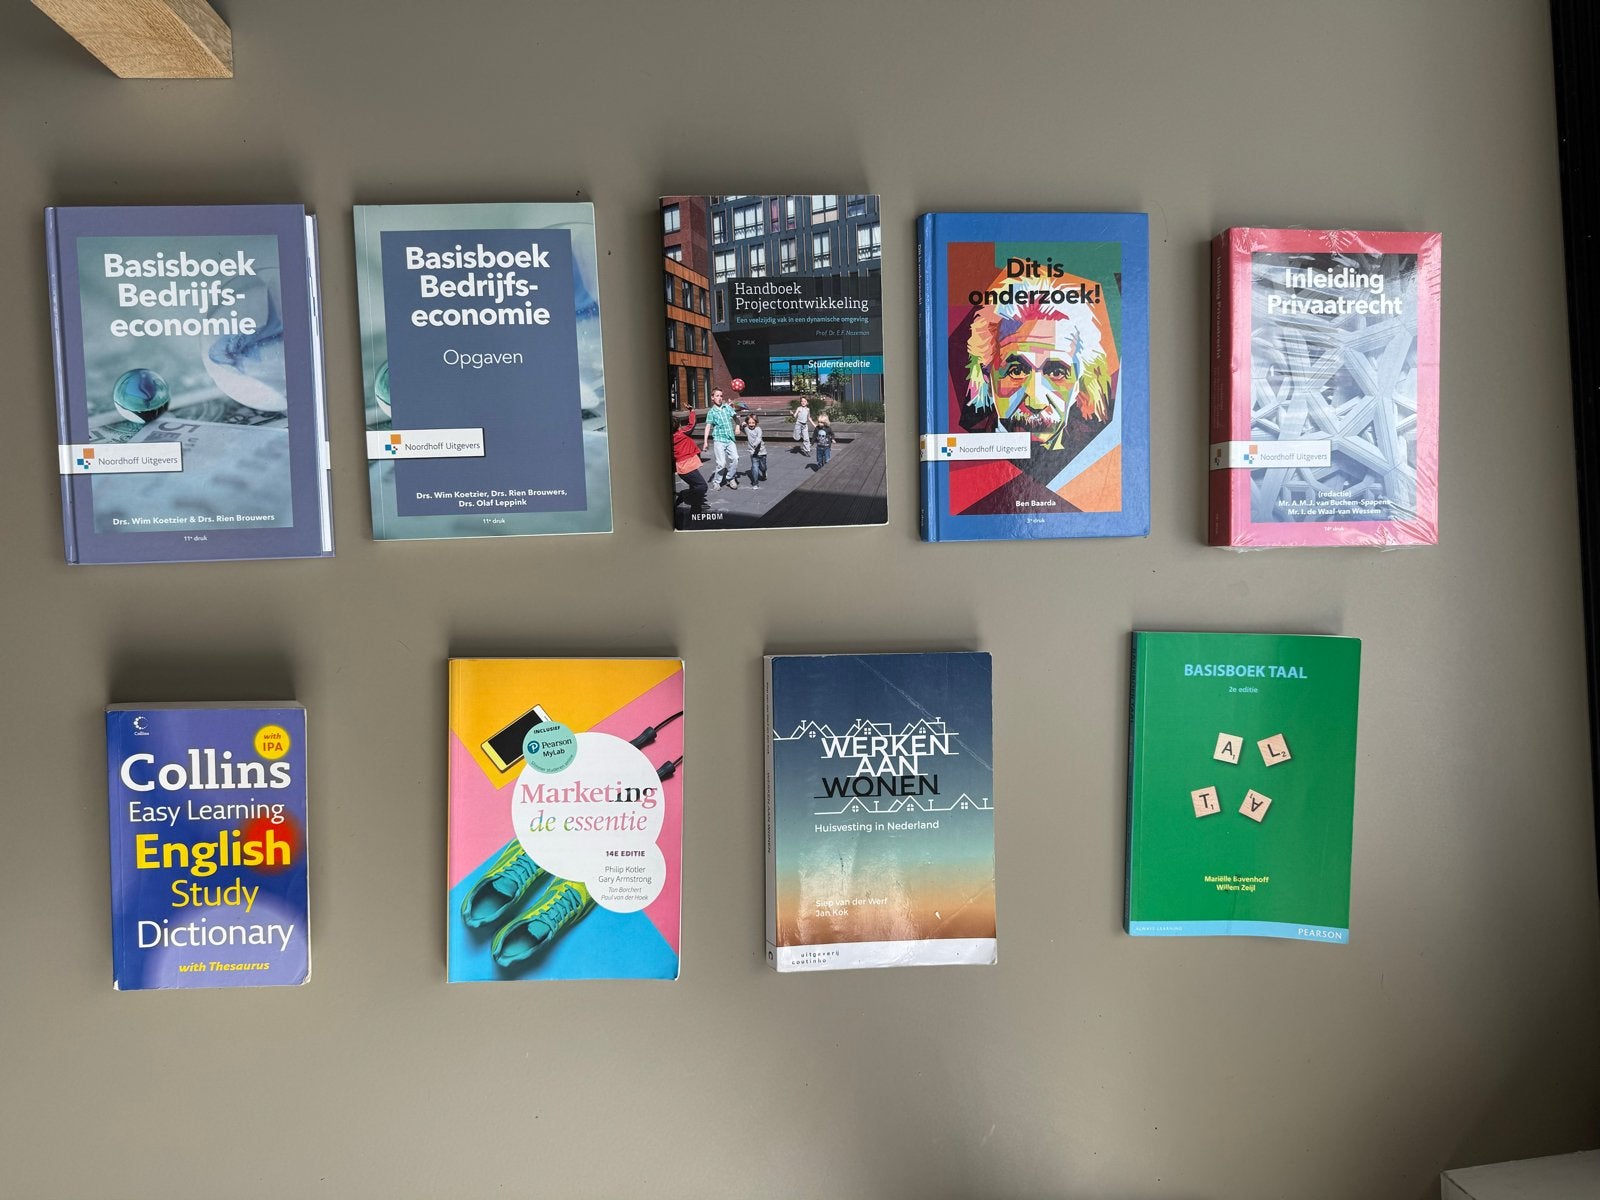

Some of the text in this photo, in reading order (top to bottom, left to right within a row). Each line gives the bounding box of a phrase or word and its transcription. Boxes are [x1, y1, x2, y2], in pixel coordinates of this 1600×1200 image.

[405, 243, 550, 270] Basisboek
[103, 250, 256, 278] Basisboek
[1006, 257, 1064, 279] Dit is
[420, 271, 538, 303] Bedrijfs-
[1285, 267, 1384, 294] Inleiding
[734, 282, 802, 296] Handboek
[968, 284, 1101, 306] onderzoek!
[118, 281, 246, 313] Bedrijfs-
[735, 296, 869, 314] Projectontwikkeling
[1267, 294, 1403, 316] Privaatrecht
[411, 301, 550, 328] economie
[747, 317, 777, 325] veelzijdig
[806, 316, 840, 324] dynamische
[840, 316, 869, 324] omgeving
[110, 310, 257, 337] economie
[443, 349, 523, 369] Opgaven
[807, 359, 871, 369] Studenteneditie
[405, 441, 481, 452] Noordhoff Uitgevers
[959, 444, 1028, 455] Noordhoff Uitgevers
[98, 455, 178, 468] Noordhoff Uitgevers
[1260, 452, 1328, 462] Noordhoff Uitgevers
[434, 491, 453, 499] Wim
[454, 490, 490, 499] Koetzier,
[509, 489, 526, 497] Rien
[528, 488, 568, 496] Brouwers,
[1318, 490, 1352, 498] (redactie)
[458, 498, 527, 508] Drs. Olaf Leppink
[1031, 499, 1056, 507] Baarda
[112, 518, 130, 526] Drs.
[132, 517, 151, 525] Wim
[153, 516, 188, 524] Koetzier
[198, 515, 215, 523] Drs.
[236, 514, 275, 522] Brouwers
[691, 513, 724, 521] NEPROM
[1184, 664, 1308, 679] BASISBOEK TAAL
[1228, 685, 1258, 694] 2e editie
[533, 725, 560, 734] INCLUSIEF
[263, 732, 282, 741] with
[262, 741, 283, 752] IPA
[541, 738, 573, 749] Pearson
[820, 733, 957, 758] WERKEN
[542, 748, 566, 758] MyLab
[120, 748, 292, 792] Collins
[850, 754, 925, 777] AAN
[819, 774, 941, 798] WONEN
[520, 780, 658, 809] Marketing
[129, 798, 285, 826] Easy Learning
[530, 809, 648, 832] de essentie
[814, 820, 940, 833] Huisvesting in Nederland
[135, 829, 291, 877] English
[604, 865, 646, 874] Philip Kotler
[598, 875, 652, 885] Gary Armstrong
[1204, 875, 1232, 883] Mariëlle
[171, 877, 259, 913] Study
[1240, 884, 1256, 893] Zeijl
[852, 898, 866, 906] der
[868, 897, 888, 905] Werf
[815, 908, 849, 917] Jan Kok
[138, 917, 294, 952] Dictionary
[1298, 927, 1343, 940] PEARSON
[179, 961, 270, 973] with Thesaurus
